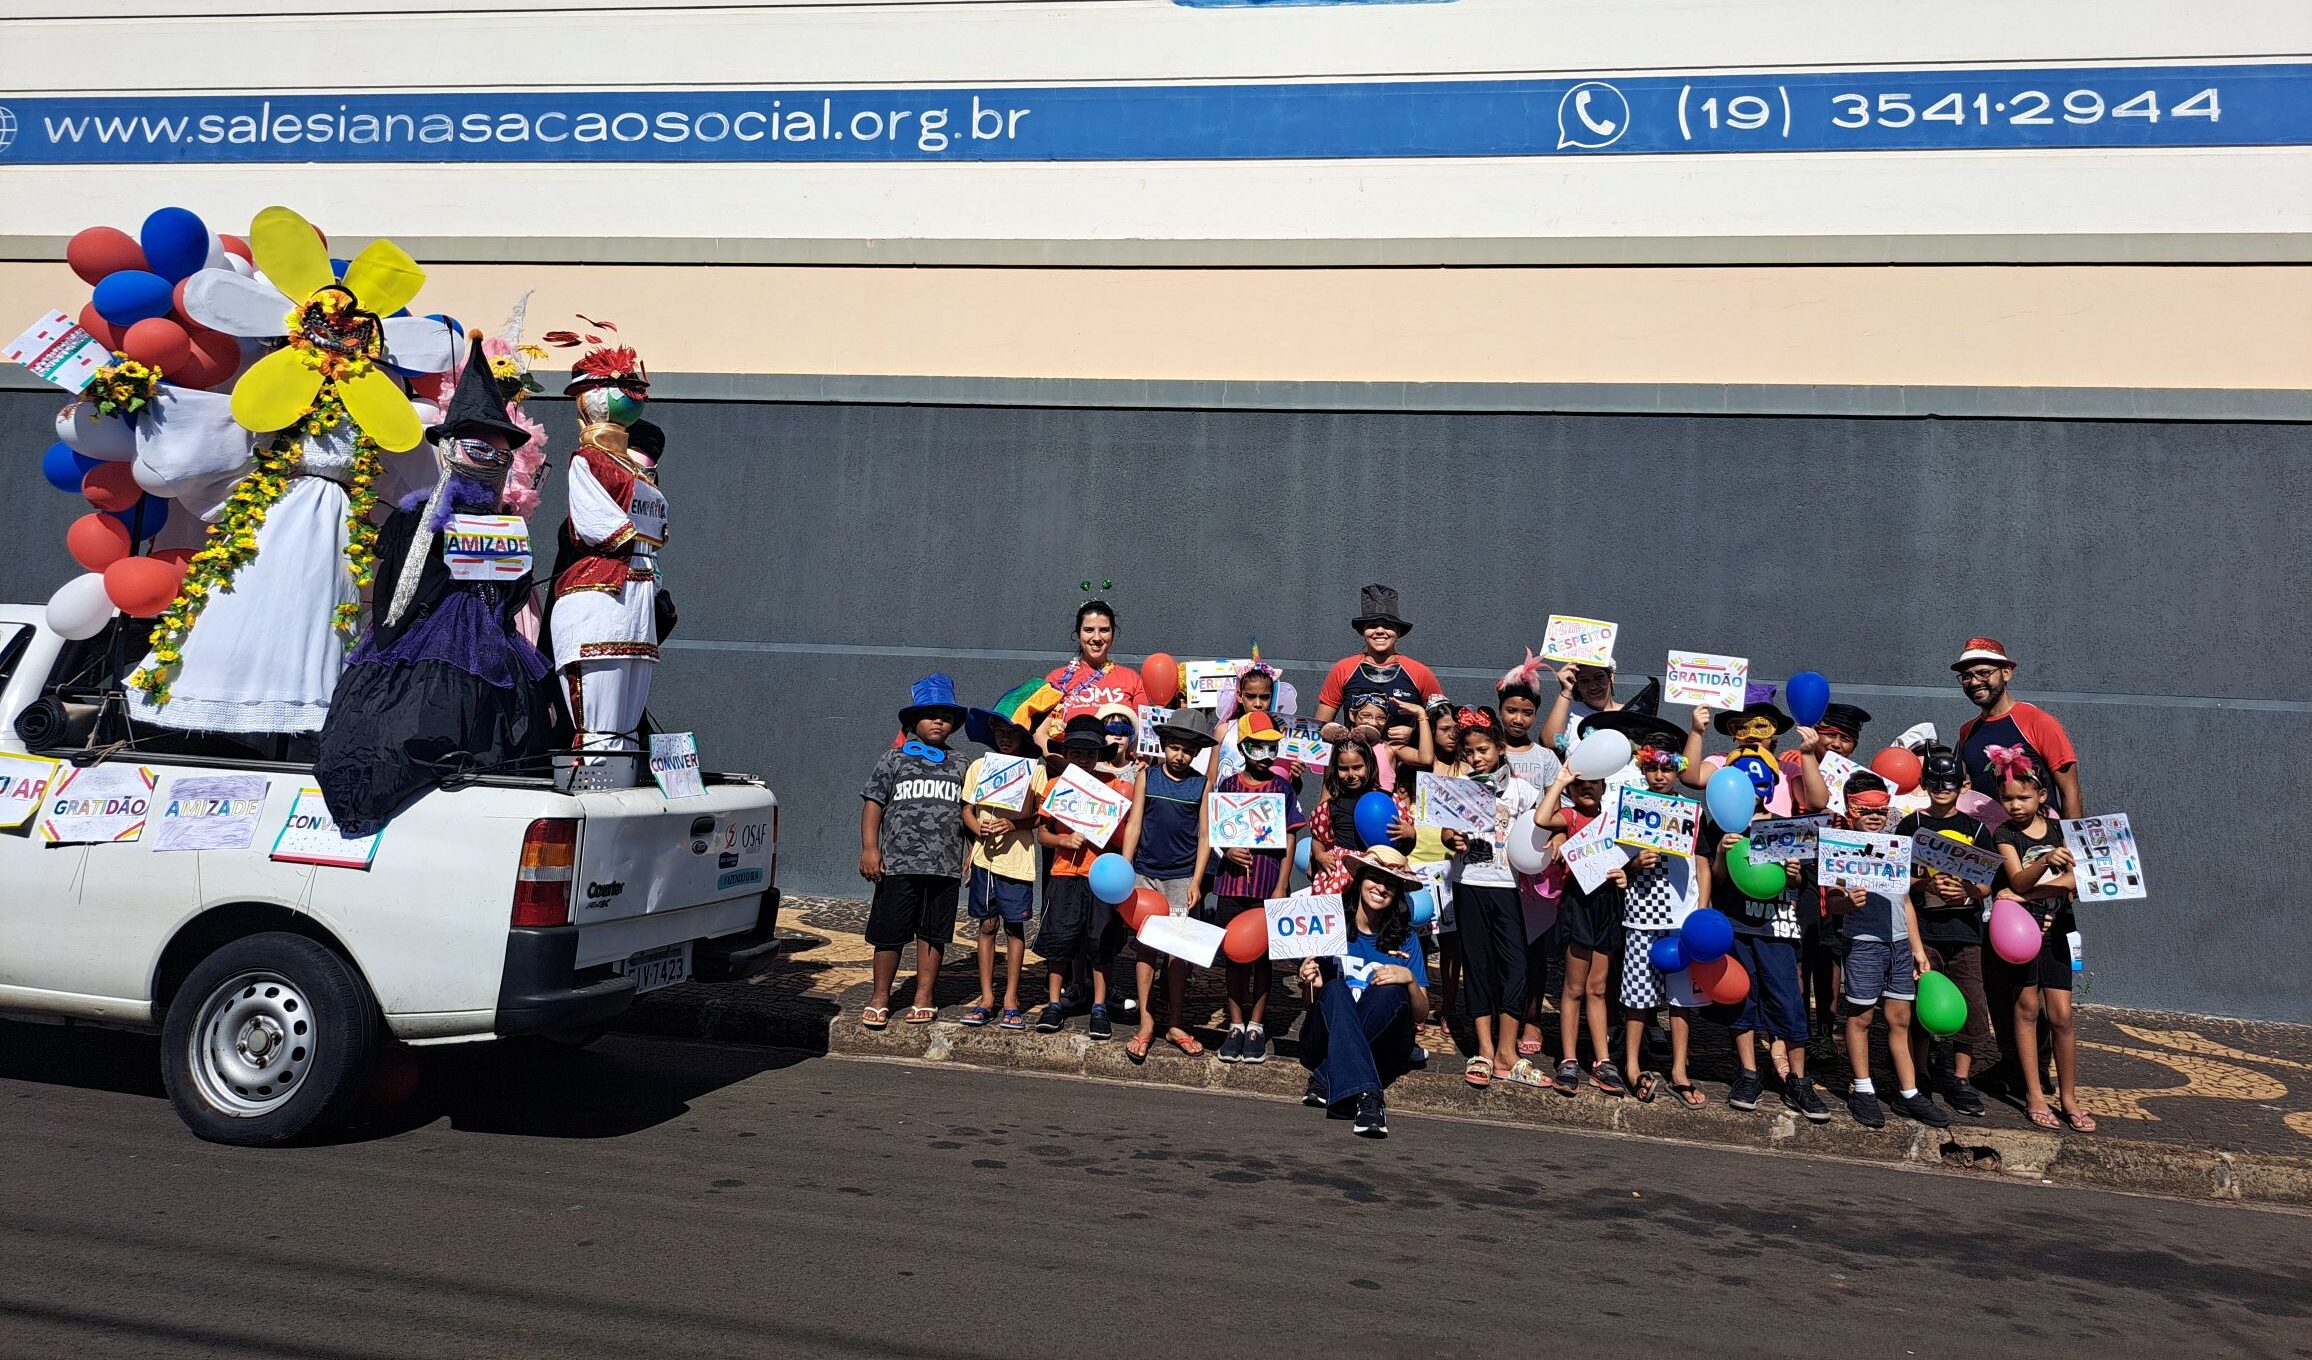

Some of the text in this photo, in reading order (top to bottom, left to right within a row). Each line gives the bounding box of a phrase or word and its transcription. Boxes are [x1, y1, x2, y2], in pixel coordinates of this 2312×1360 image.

[44, 95, 1032, 151] www.salesianasacaosocial.org.br
[1678, 84, 1791, 141] (19)
[447, 535, 528, 552] AMIZADE
[1548, 628, 1611, 654] RESPEITO
[1190, 677, 1237, 690] VERDA
[1668, 670, 1743, 688] GRATIDÃO
[651, 753, 698, 773] CONVIVER
[54, 795, 146, 816] GRATIDÃO
[165, 800, 260, 817] AMIZADE
[1051, 798, 1118, 817] ESCUTAR
[1421, 774, 1486, 831] CONVERSAR
[1219, 800, 1273, 840] OSAF
[1620, 805, 1695, 837] APOIAR
[742, 823, 768, 848] OSAF
[1825, 857, 1908, 880] ESCUTAR
[2085, 818, 2119, 896] RESPEITO
[1745, 900, 1798, 921] WAVE
[1277, 914, 1336, 937] OSAF
